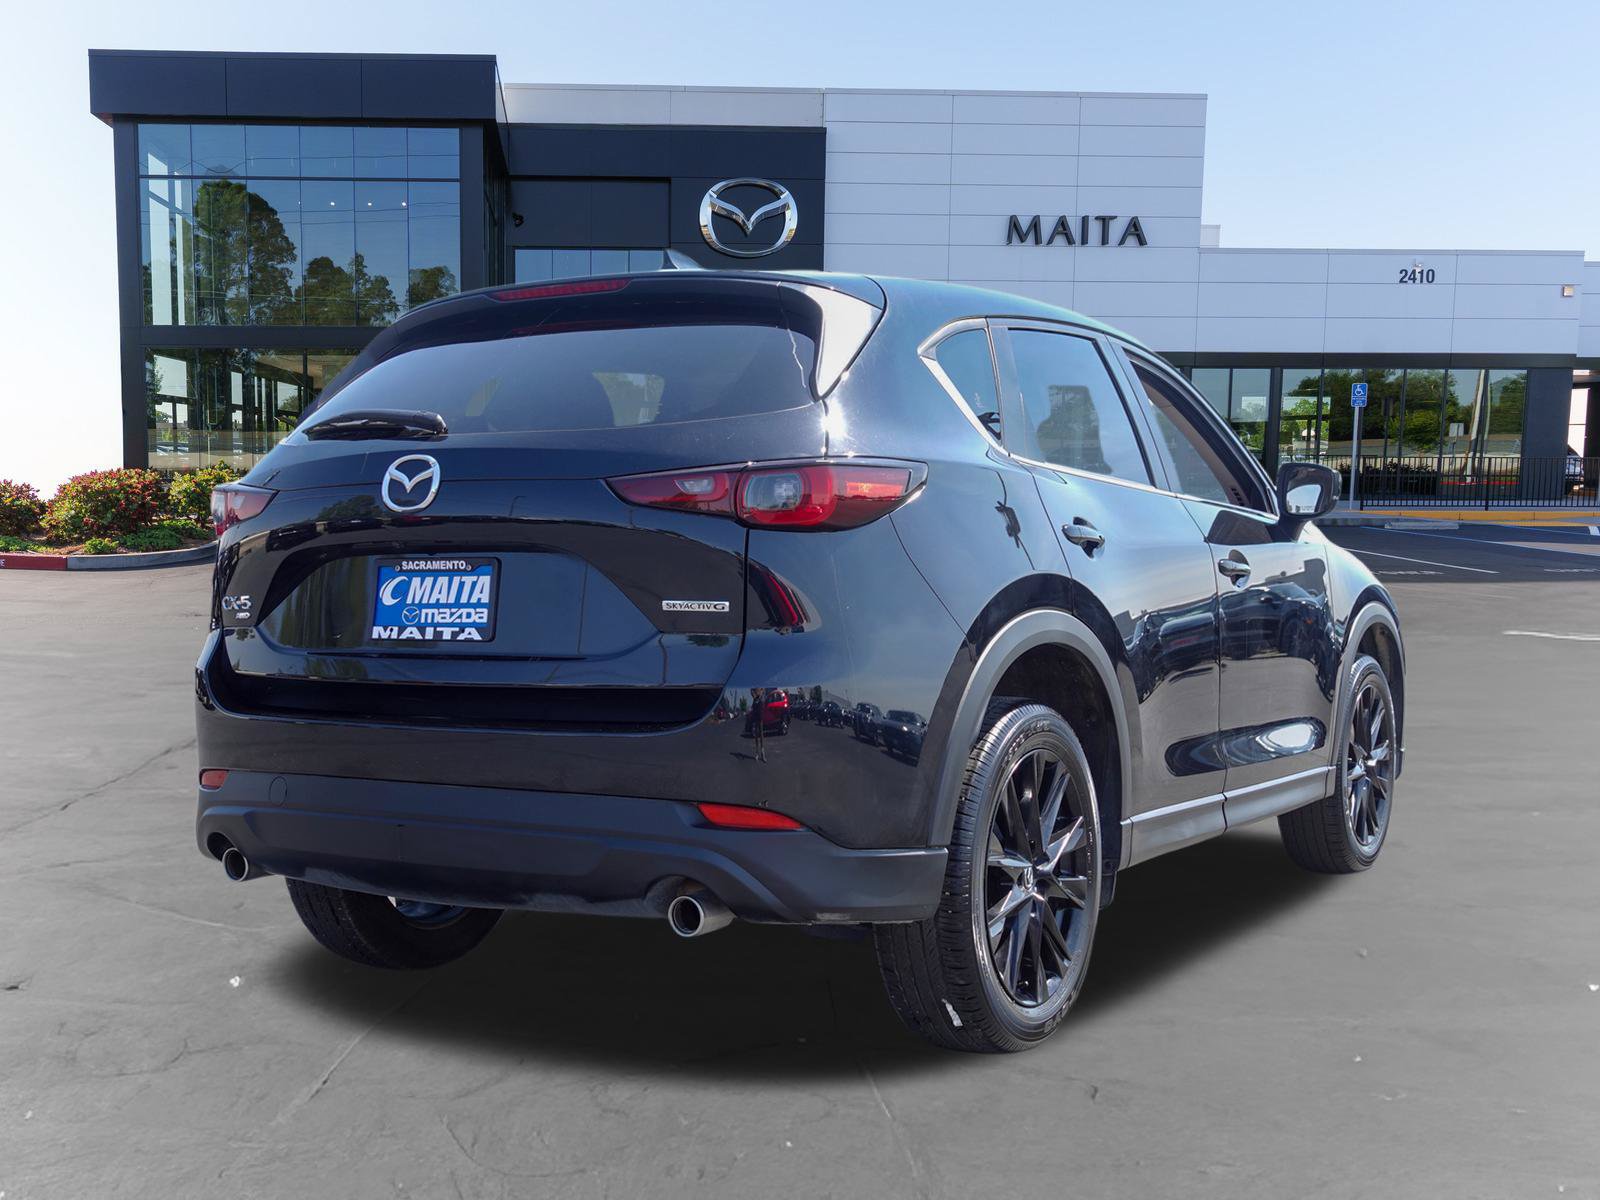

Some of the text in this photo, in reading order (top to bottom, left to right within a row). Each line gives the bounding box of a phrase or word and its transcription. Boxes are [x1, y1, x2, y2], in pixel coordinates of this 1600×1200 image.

[1006, 215, 1148, 246] MAITA
[1399, 269, 1435, 284] 2410
[402, 561, 466, 570] SACRAMENTO
[406, 576, 490, 604] MAITA
[222, 595, 251, 610] CX-5
[371, 626, 482, 640] MAITA
